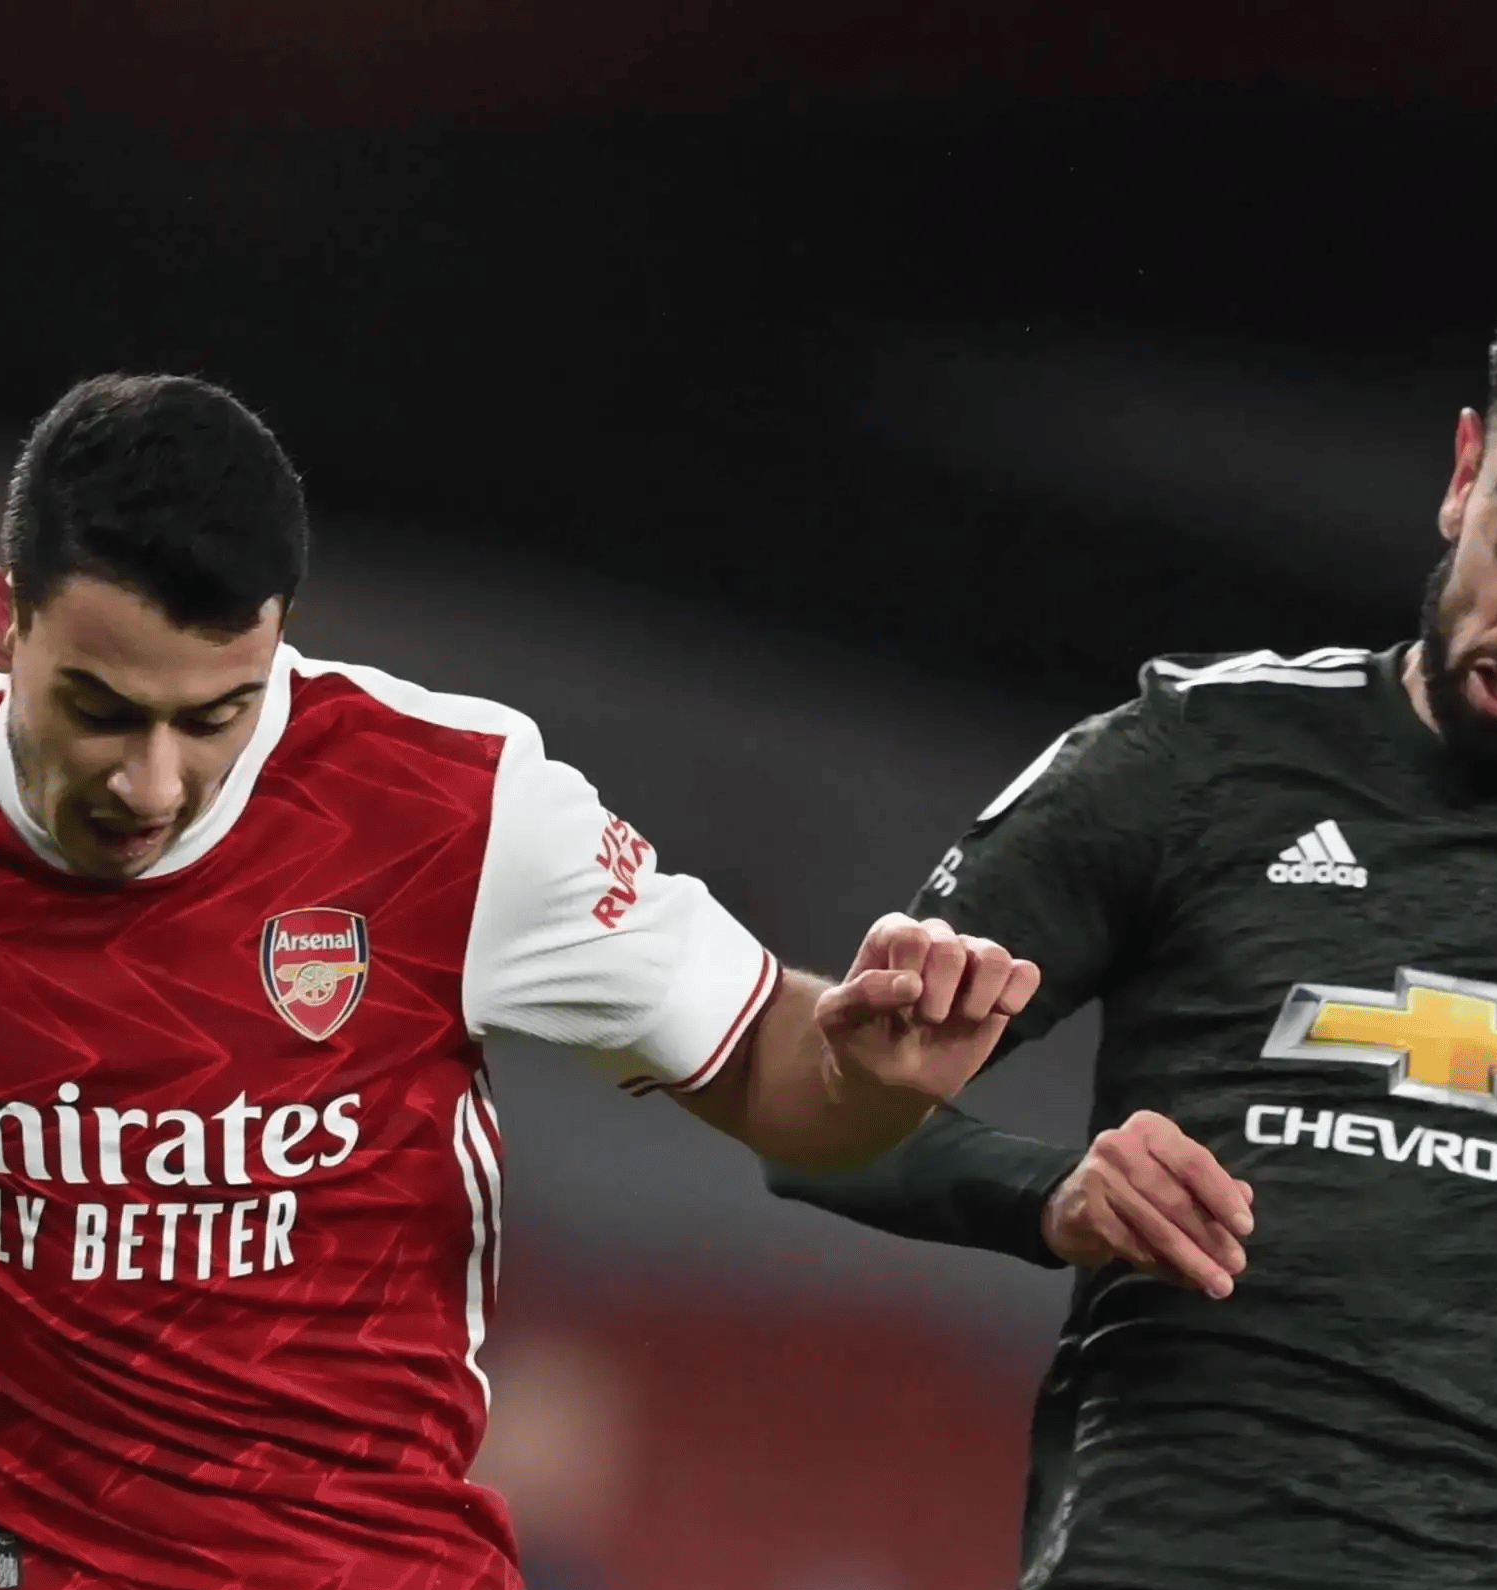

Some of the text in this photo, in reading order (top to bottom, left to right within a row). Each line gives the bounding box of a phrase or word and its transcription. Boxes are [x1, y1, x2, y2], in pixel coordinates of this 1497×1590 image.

[1267, 863, 1368, 888] adidas
[275, 928, 353, 952] Arsenal
[71, 1191, 297, 1281] BETTER
